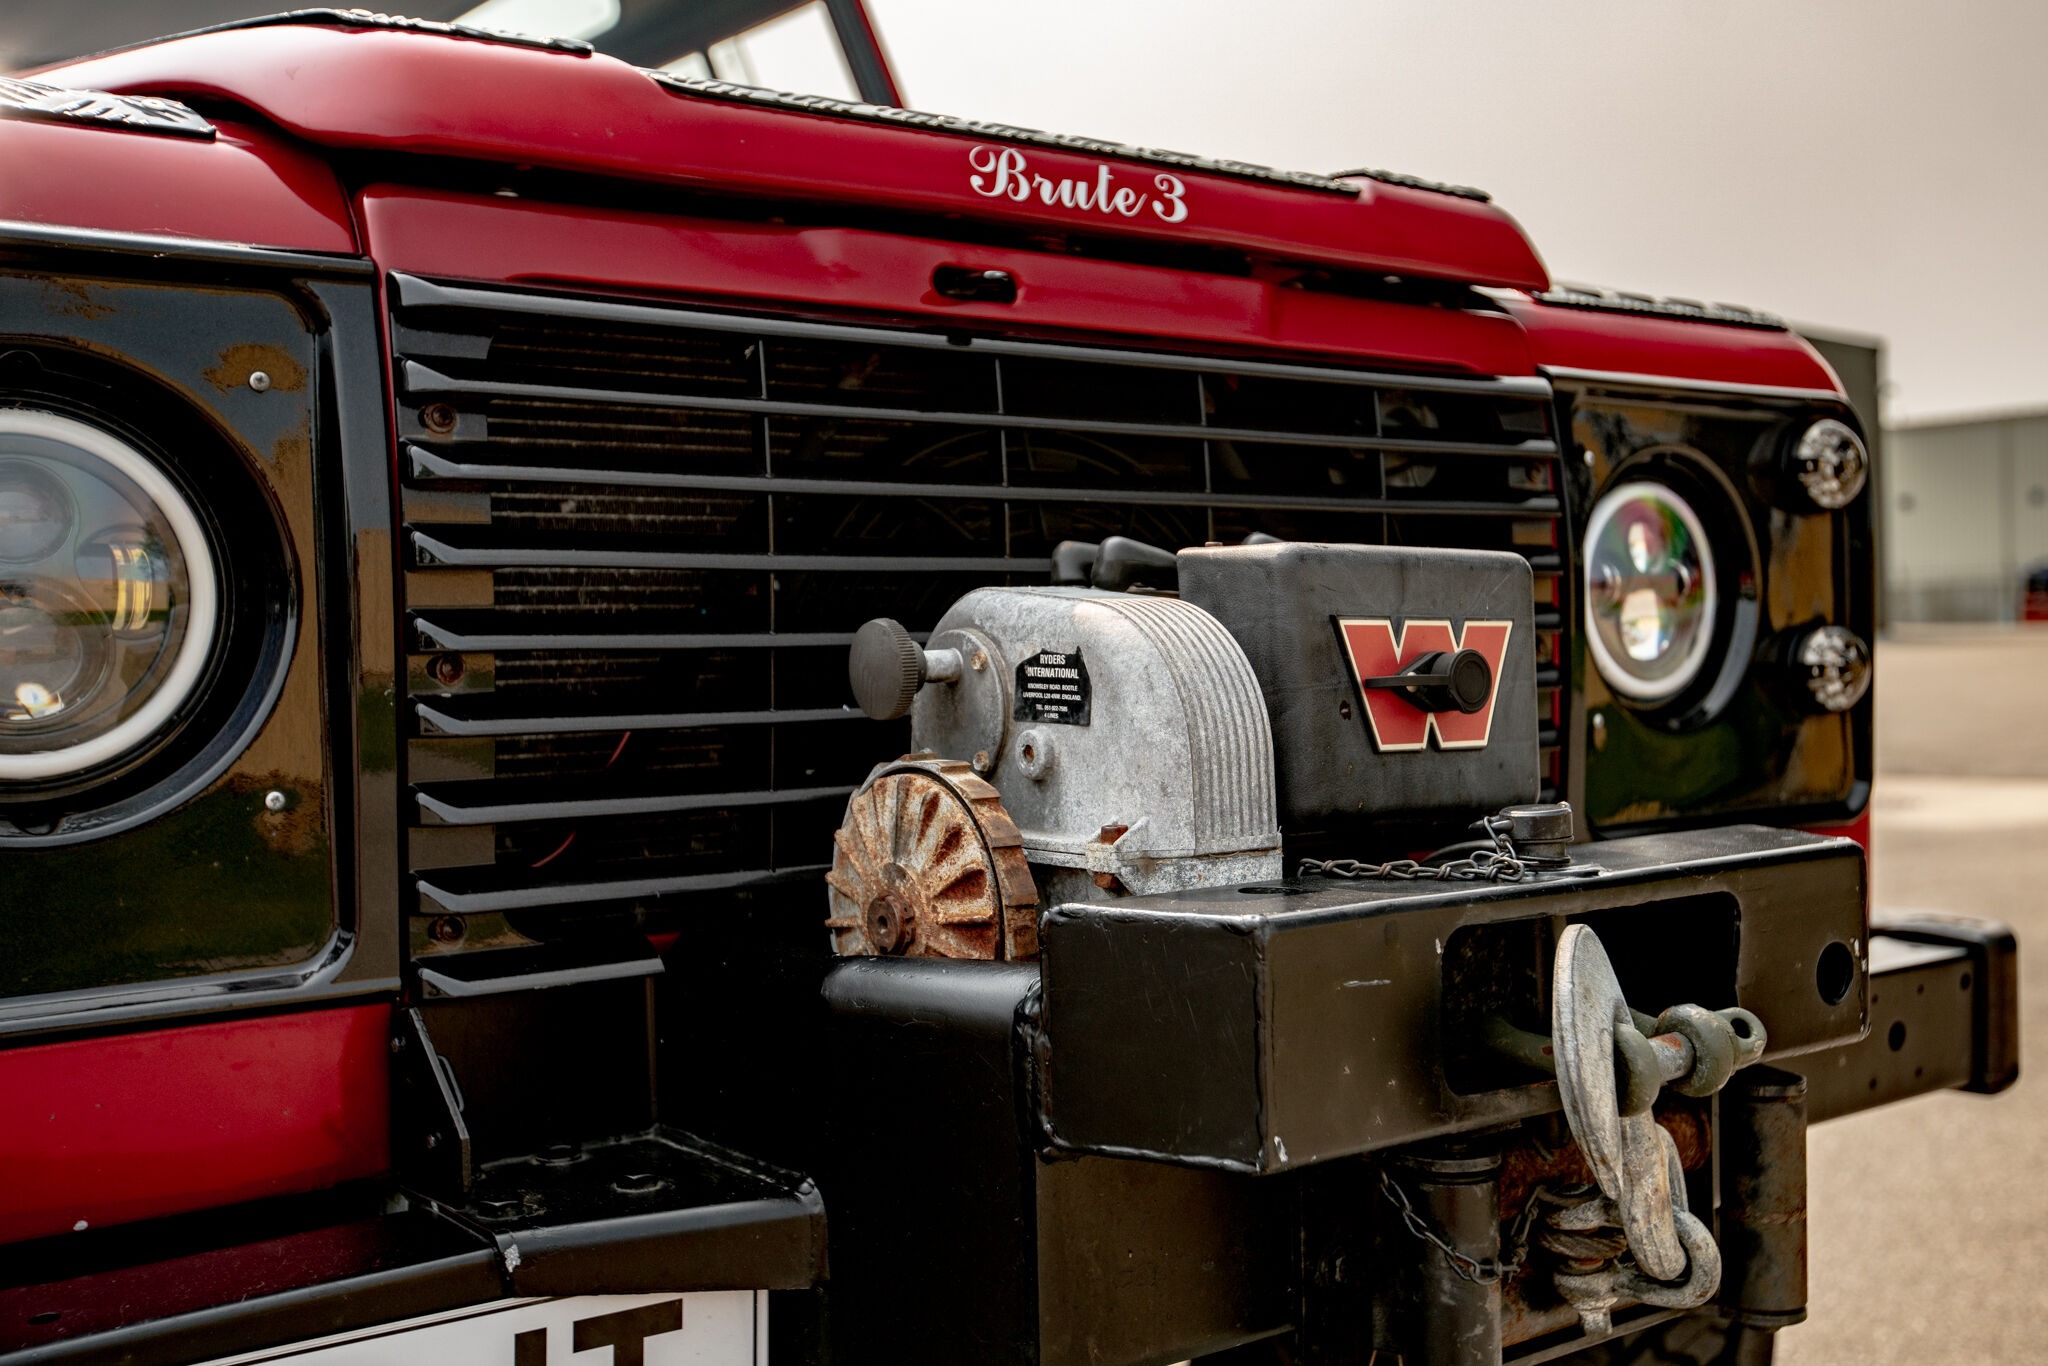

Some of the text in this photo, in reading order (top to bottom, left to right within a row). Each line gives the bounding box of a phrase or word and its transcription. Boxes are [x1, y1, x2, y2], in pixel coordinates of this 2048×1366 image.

[969, 145, 1189, 223] Brute 3
[1027, 666, 1079, 679] INTERNATIONAL
[1039, 654, 1066, 665] RYDERS
[1338, 618, 1514, 753] W
